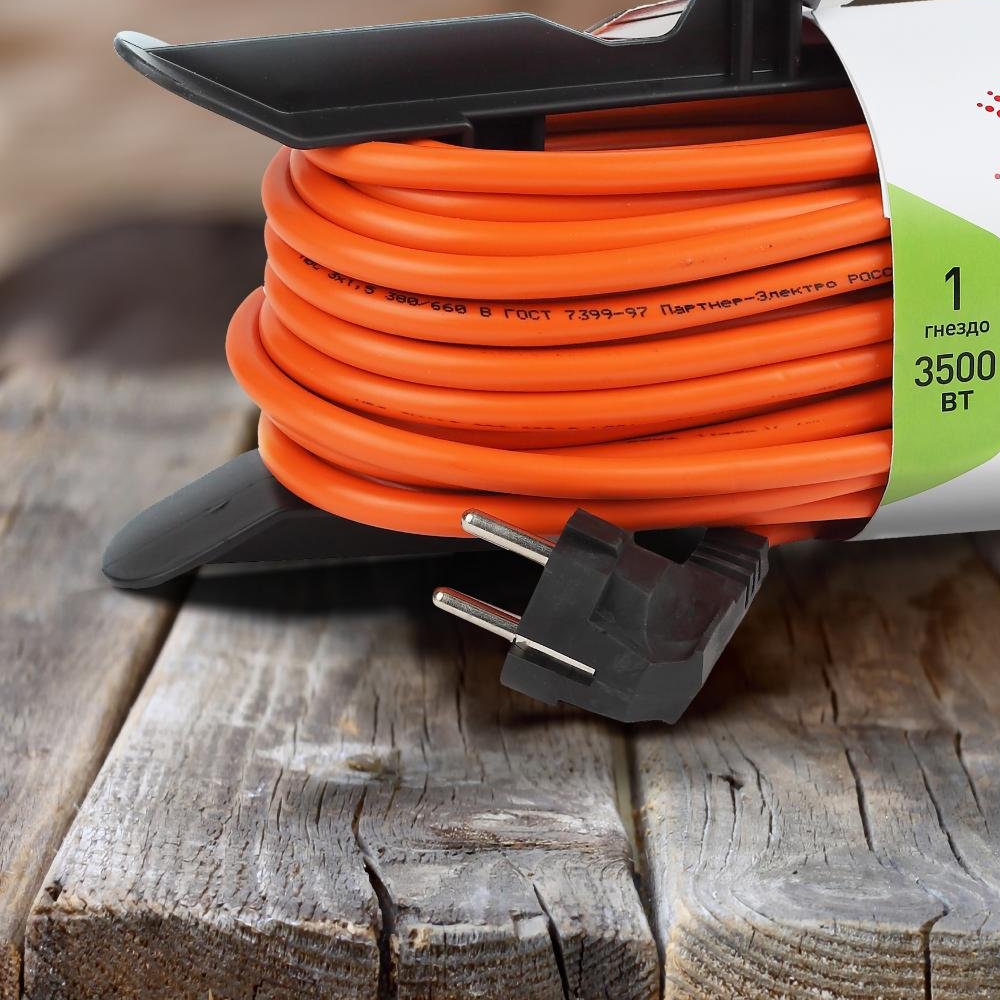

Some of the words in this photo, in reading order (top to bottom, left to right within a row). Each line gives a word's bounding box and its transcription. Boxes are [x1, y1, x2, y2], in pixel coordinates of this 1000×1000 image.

[503, 308, 553, 321] ГОСТ
[565, 305, 649, 321] 7399-97
[660, 279, 838, 317] Партнер-Электро
[945, 266, 961, 311] 1
[925, 319, 990, 339] гнездо
[914, 349, 996, 388] 3500
